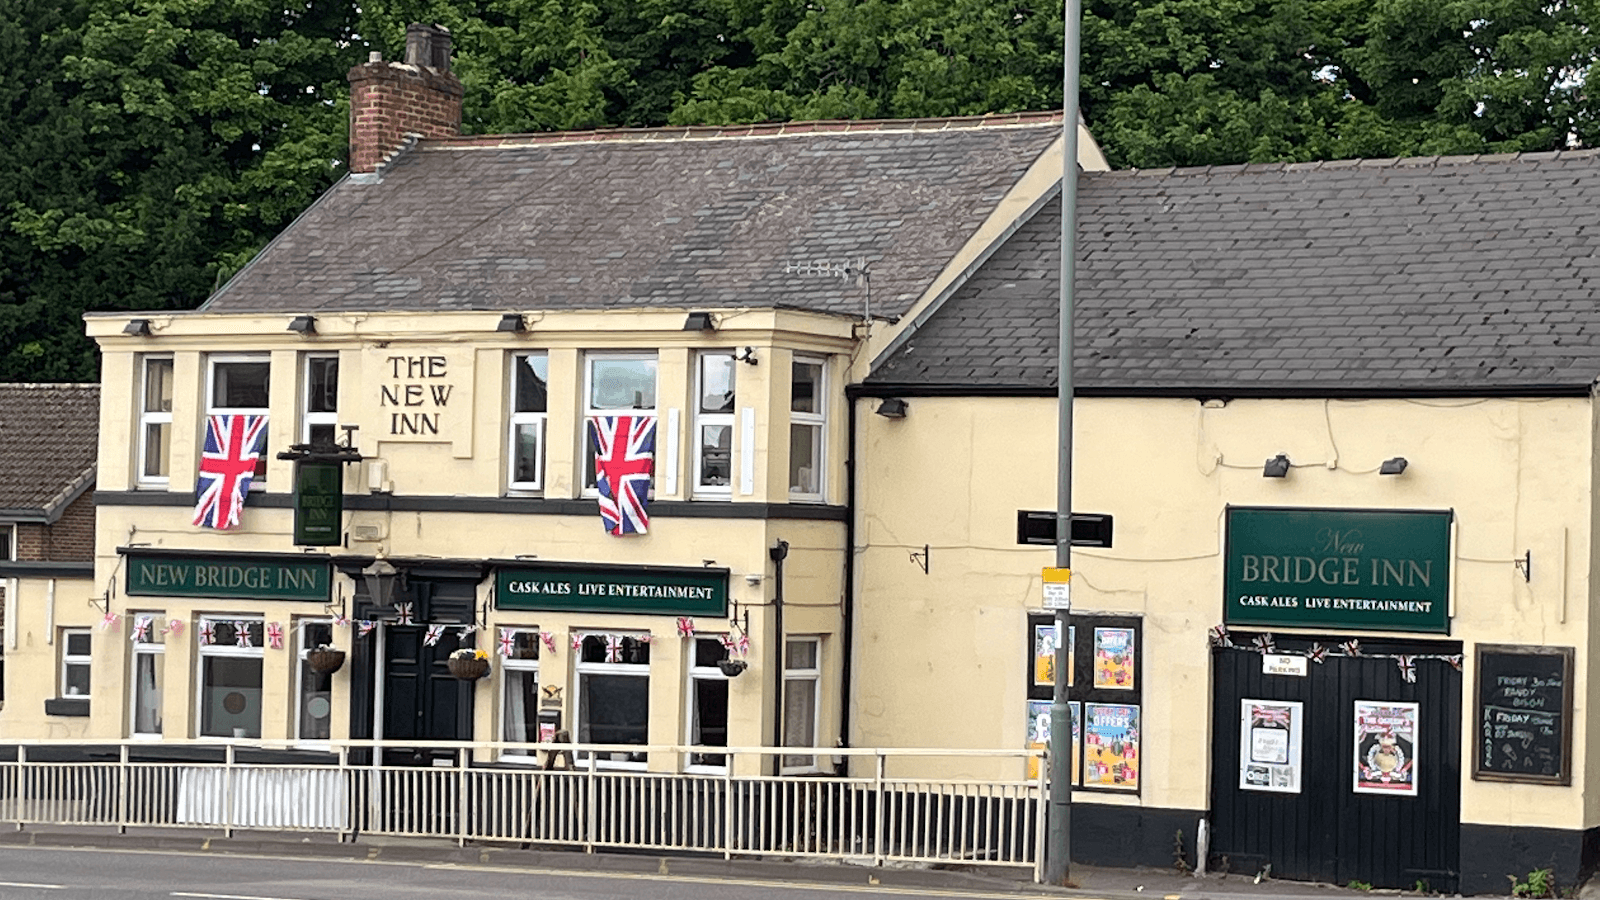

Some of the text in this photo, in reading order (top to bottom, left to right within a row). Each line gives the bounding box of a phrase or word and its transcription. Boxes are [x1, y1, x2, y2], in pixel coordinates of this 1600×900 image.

[386, 356, 447, 378] THE
[380, 384, 454, 407] NEW
[390, 413, 441, 435] INN
[1311, 527, 1365, 554] New
[140, 563, 317, 589] NEW BRIDGE INN
[1241, 555, 1433, 588] BRIDGE INN
[509, 581, 714, 600] CASK ALES LIVE ENTERTAINMENT
[1239, 595, 1433, 613] CASK ALES LIVE ENTERTAINMENT
[1093, 714, 1130, 728] OFFERS
[1496, 712, 1531, 724] FRIDAY
